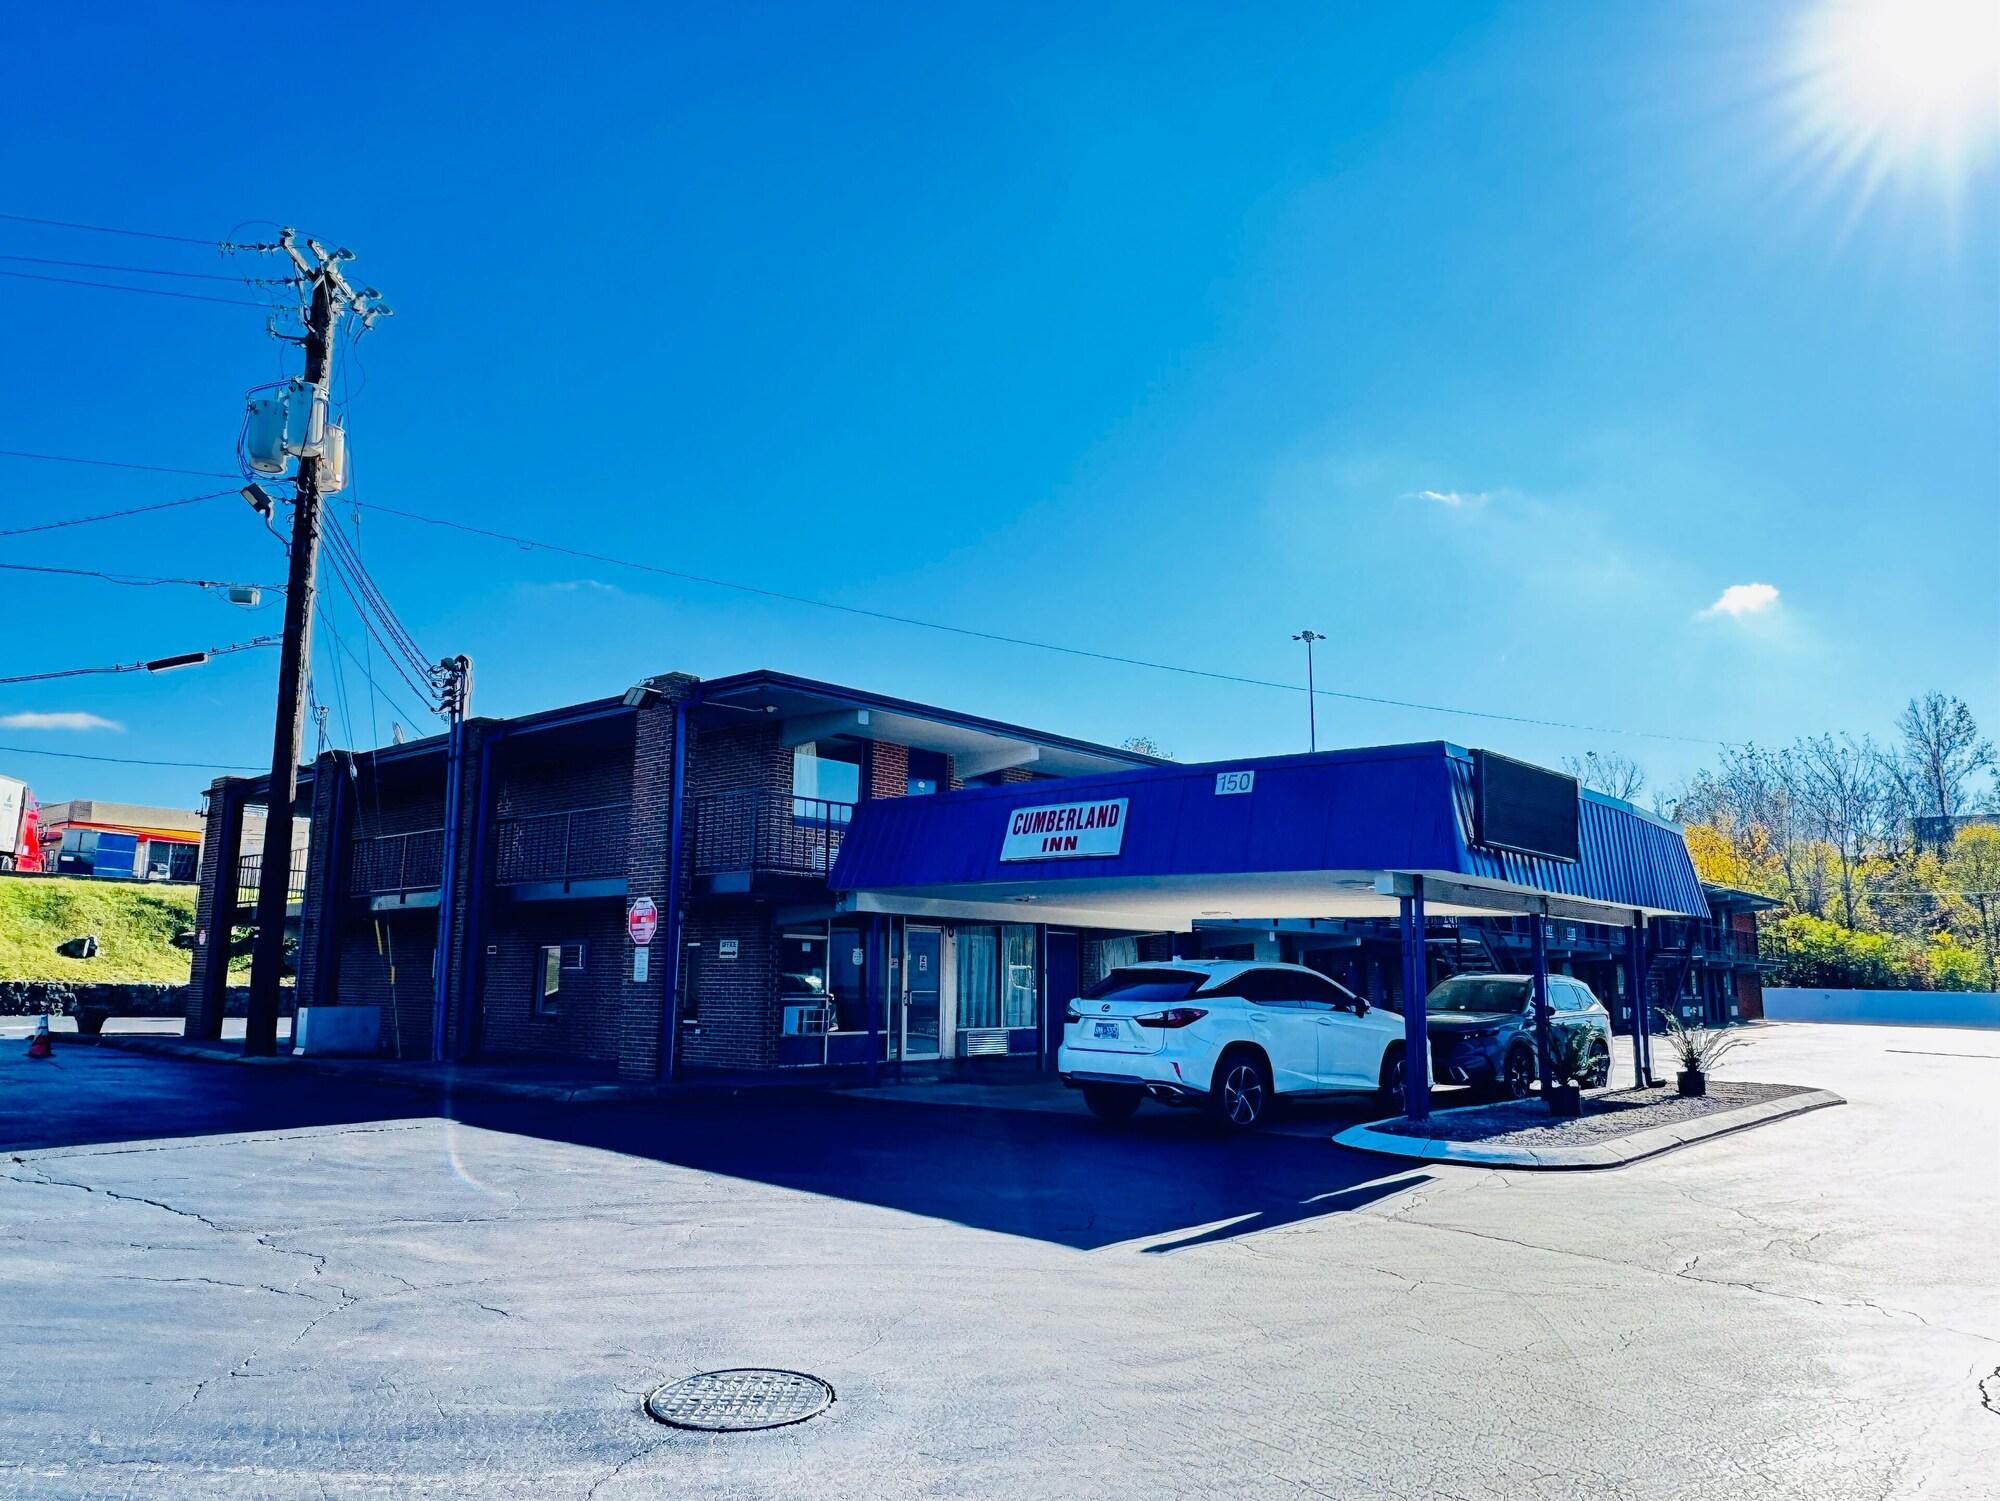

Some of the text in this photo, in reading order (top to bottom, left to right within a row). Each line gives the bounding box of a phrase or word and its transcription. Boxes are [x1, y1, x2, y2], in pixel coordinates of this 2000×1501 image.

[1219, 773, 1250, 792] 150
[1012, 804, 1120, 835] CUMBERLAND
[1041, 836, 1078, 852] INN
